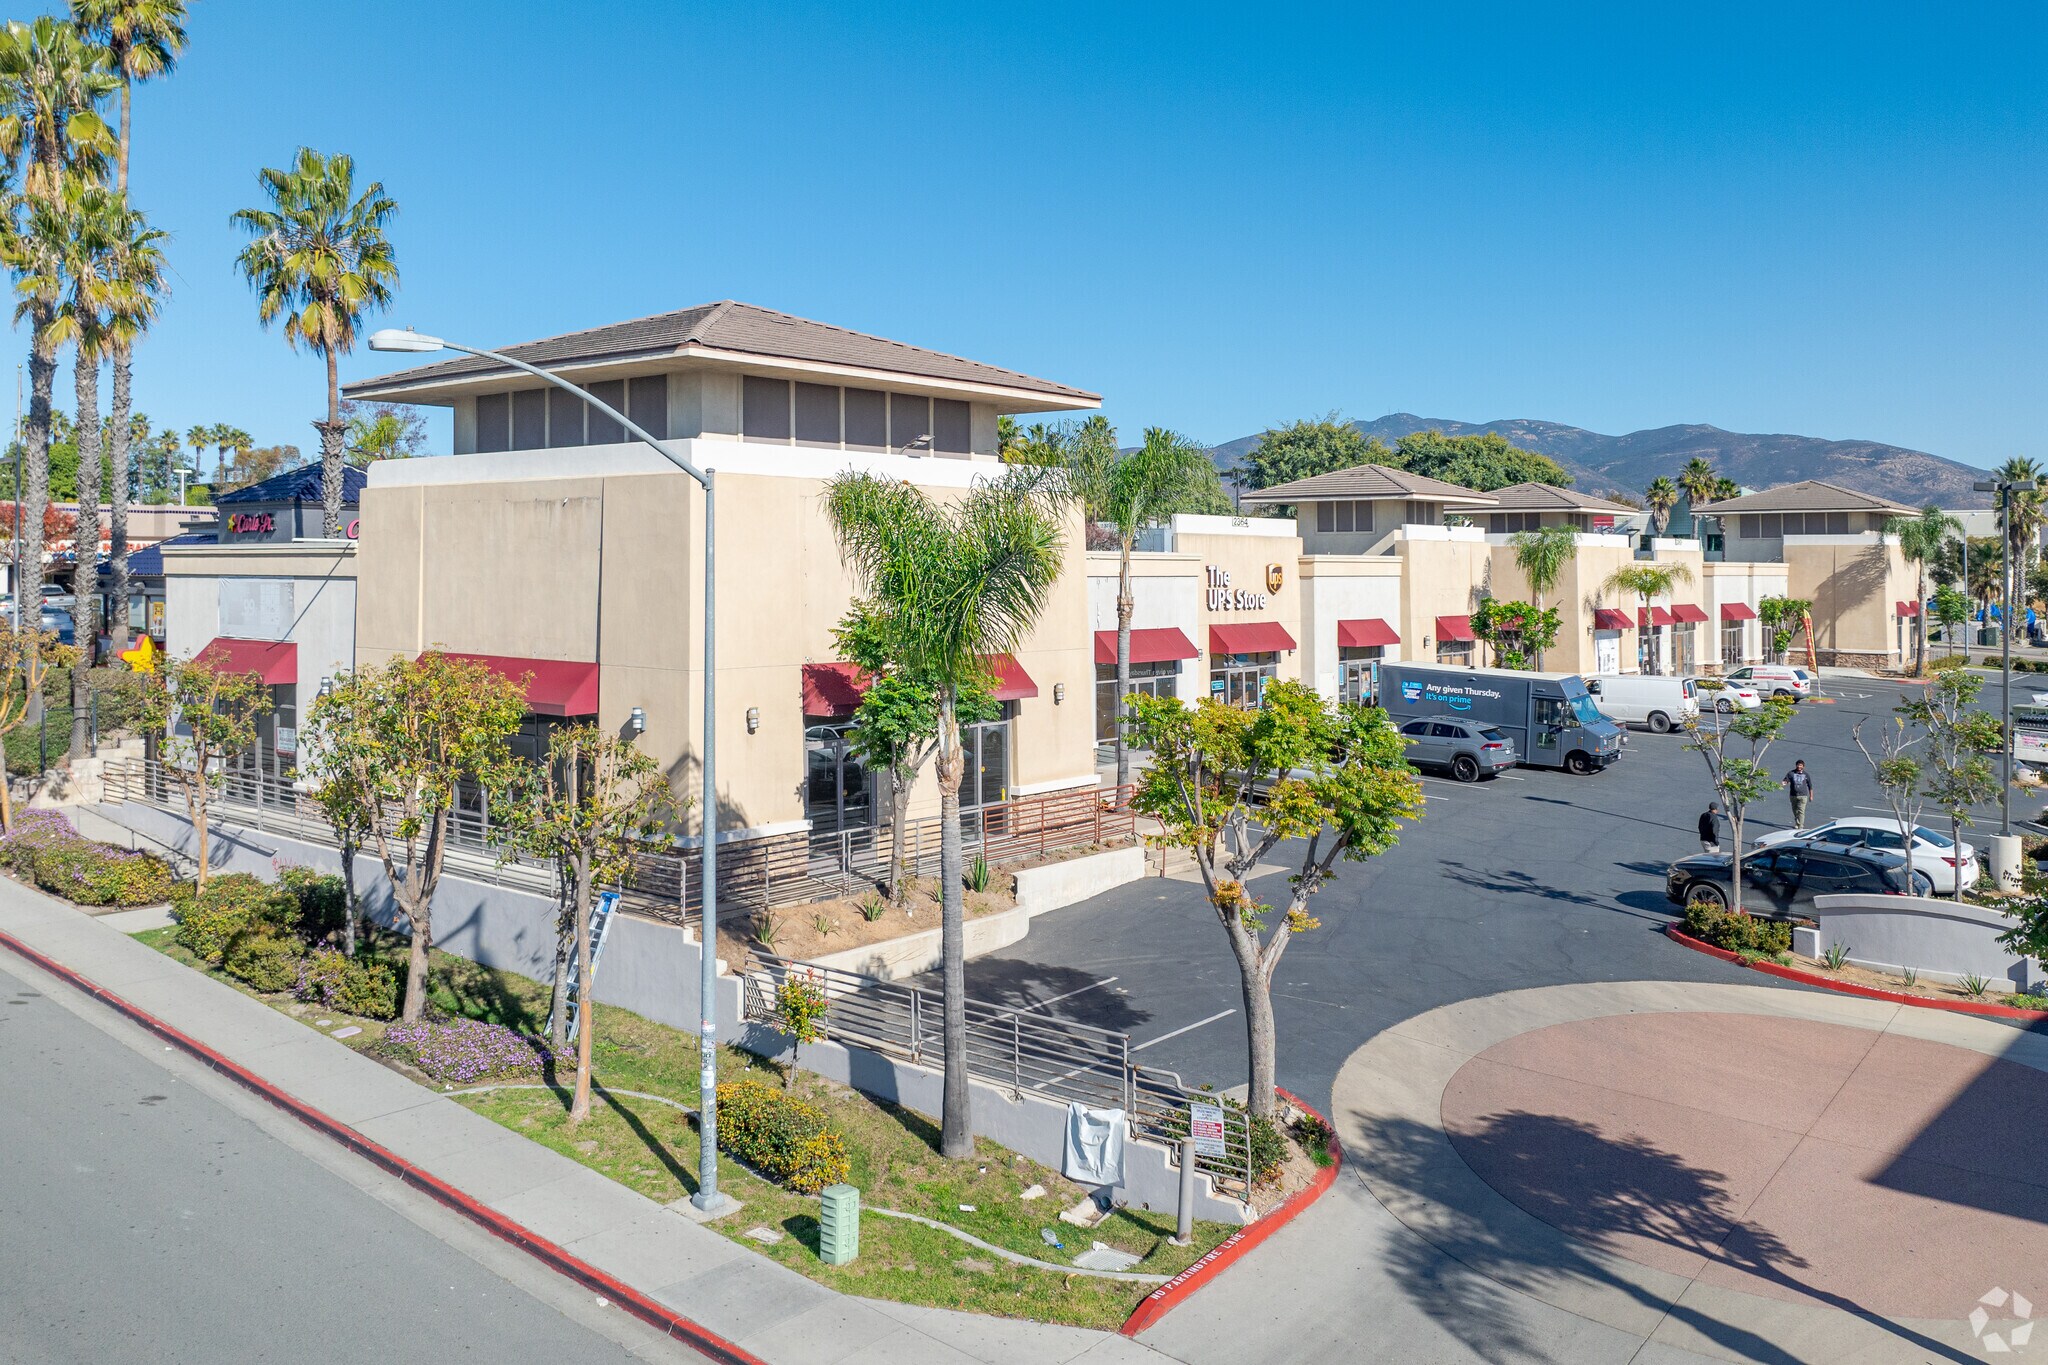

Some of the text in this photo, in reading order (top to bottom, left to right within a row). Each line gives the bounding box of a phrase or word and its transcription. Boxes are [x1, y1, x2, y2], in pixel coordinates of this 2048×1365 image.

[1206, 565, 1231, 588] The
[1270, 572, 1282, 589] ups
[1206, 588, 1266, 611] UPS Store
[1425, 693, 1437, 701] It's
[1449, 696, 1472, 704] prime
[1426, 684, 1441, 694] Any
[1442, 685, 1463, 694] given
[1464, 687, 1501, 699] Thursday.
[1149, 1232, 1246, 1300] NO PARKING FIRE LANE
